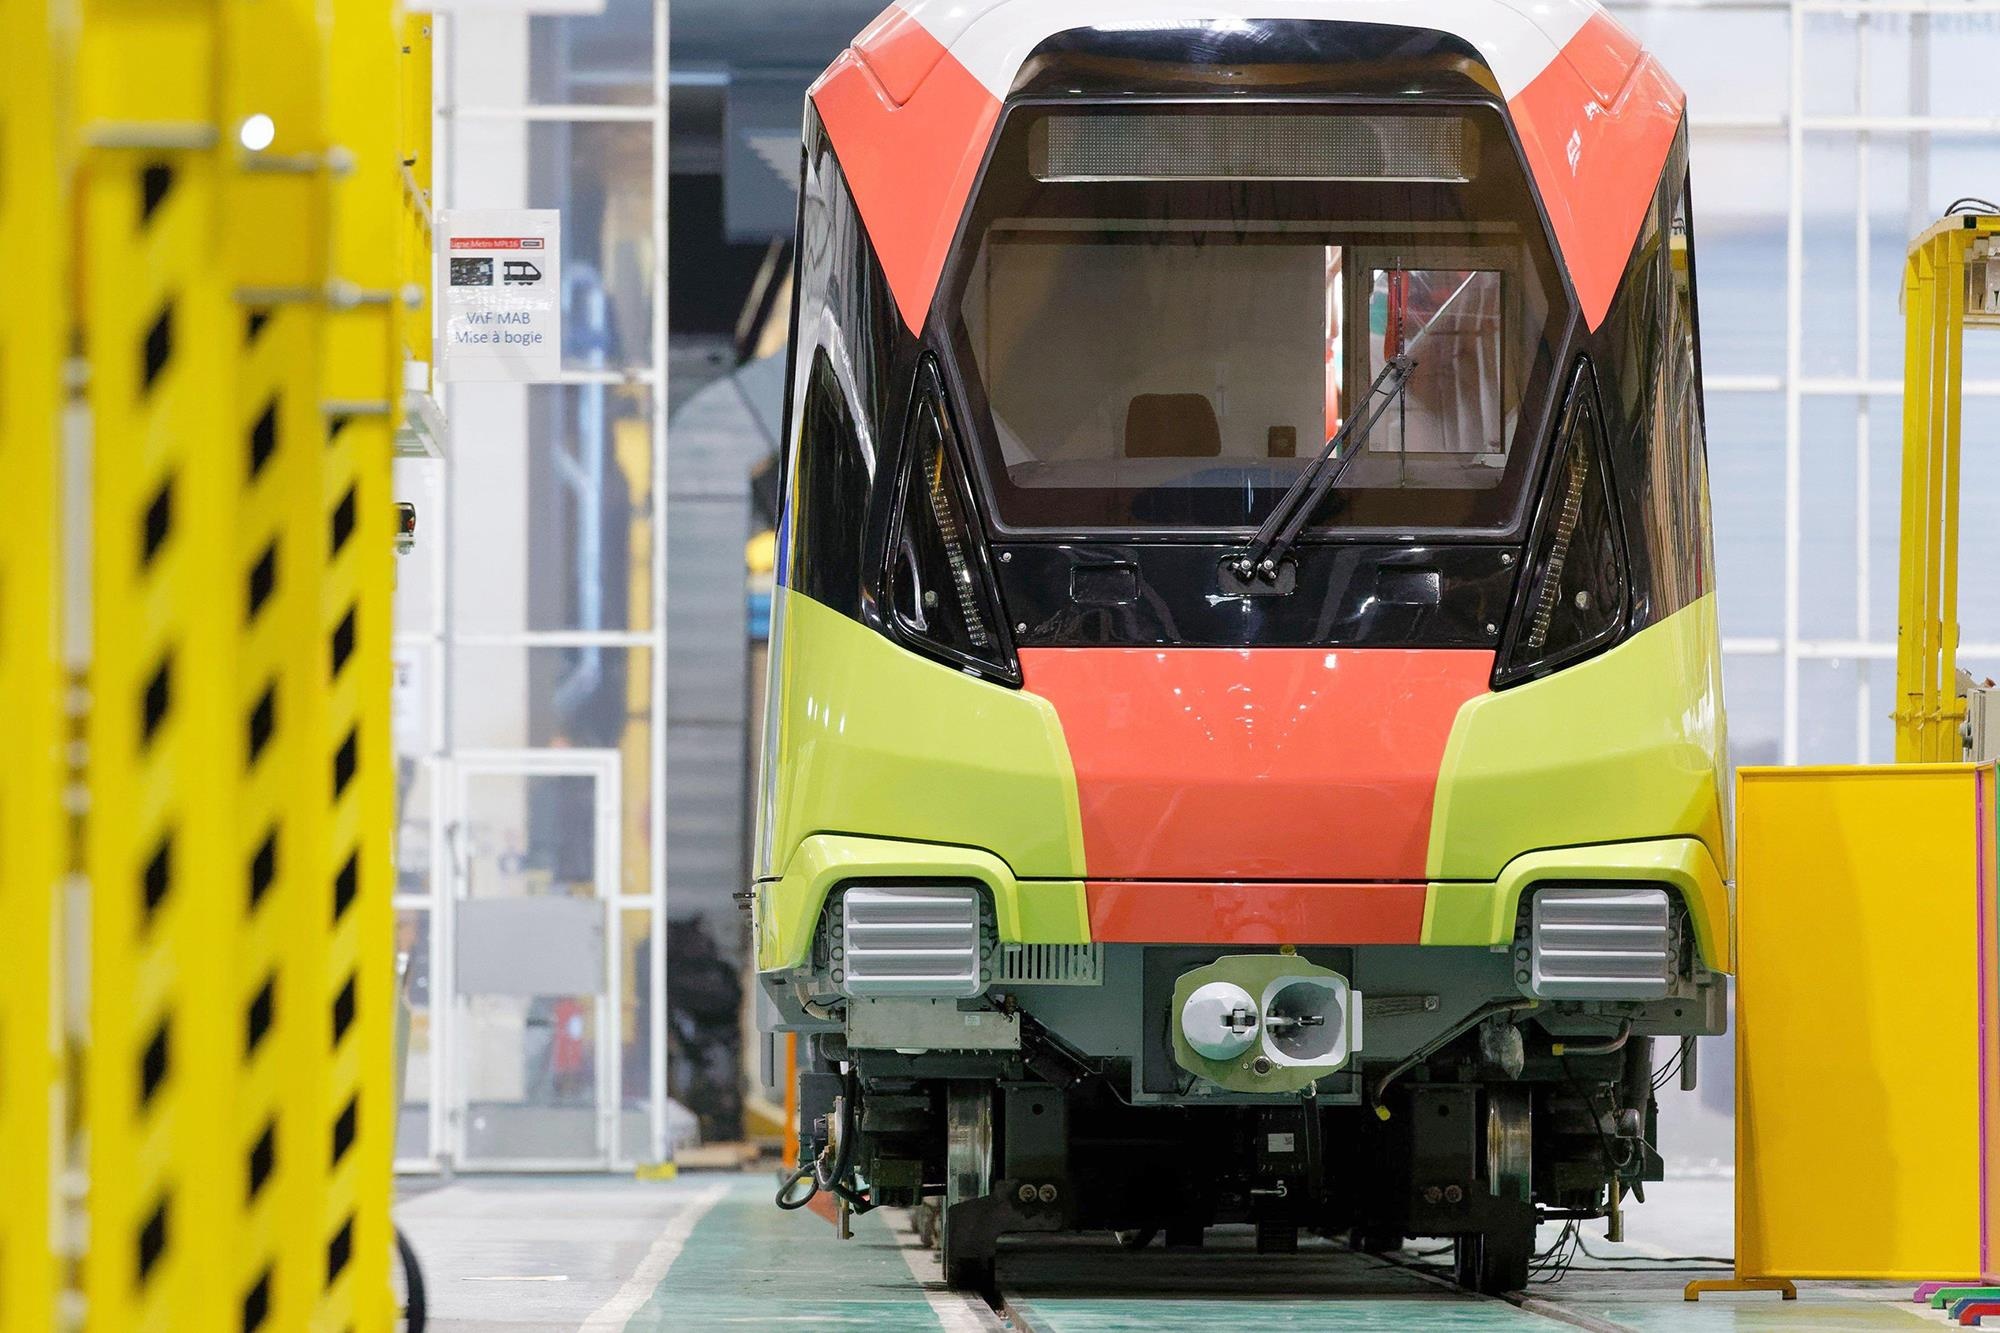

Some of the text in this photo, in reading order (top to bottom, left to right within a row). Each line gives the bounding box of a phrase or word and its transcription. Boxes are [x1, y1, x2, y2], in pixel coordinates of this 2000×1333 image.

[466, 312, 531, 324] VAF MAB
[455, 331, 542, 346] Mise à bogie
